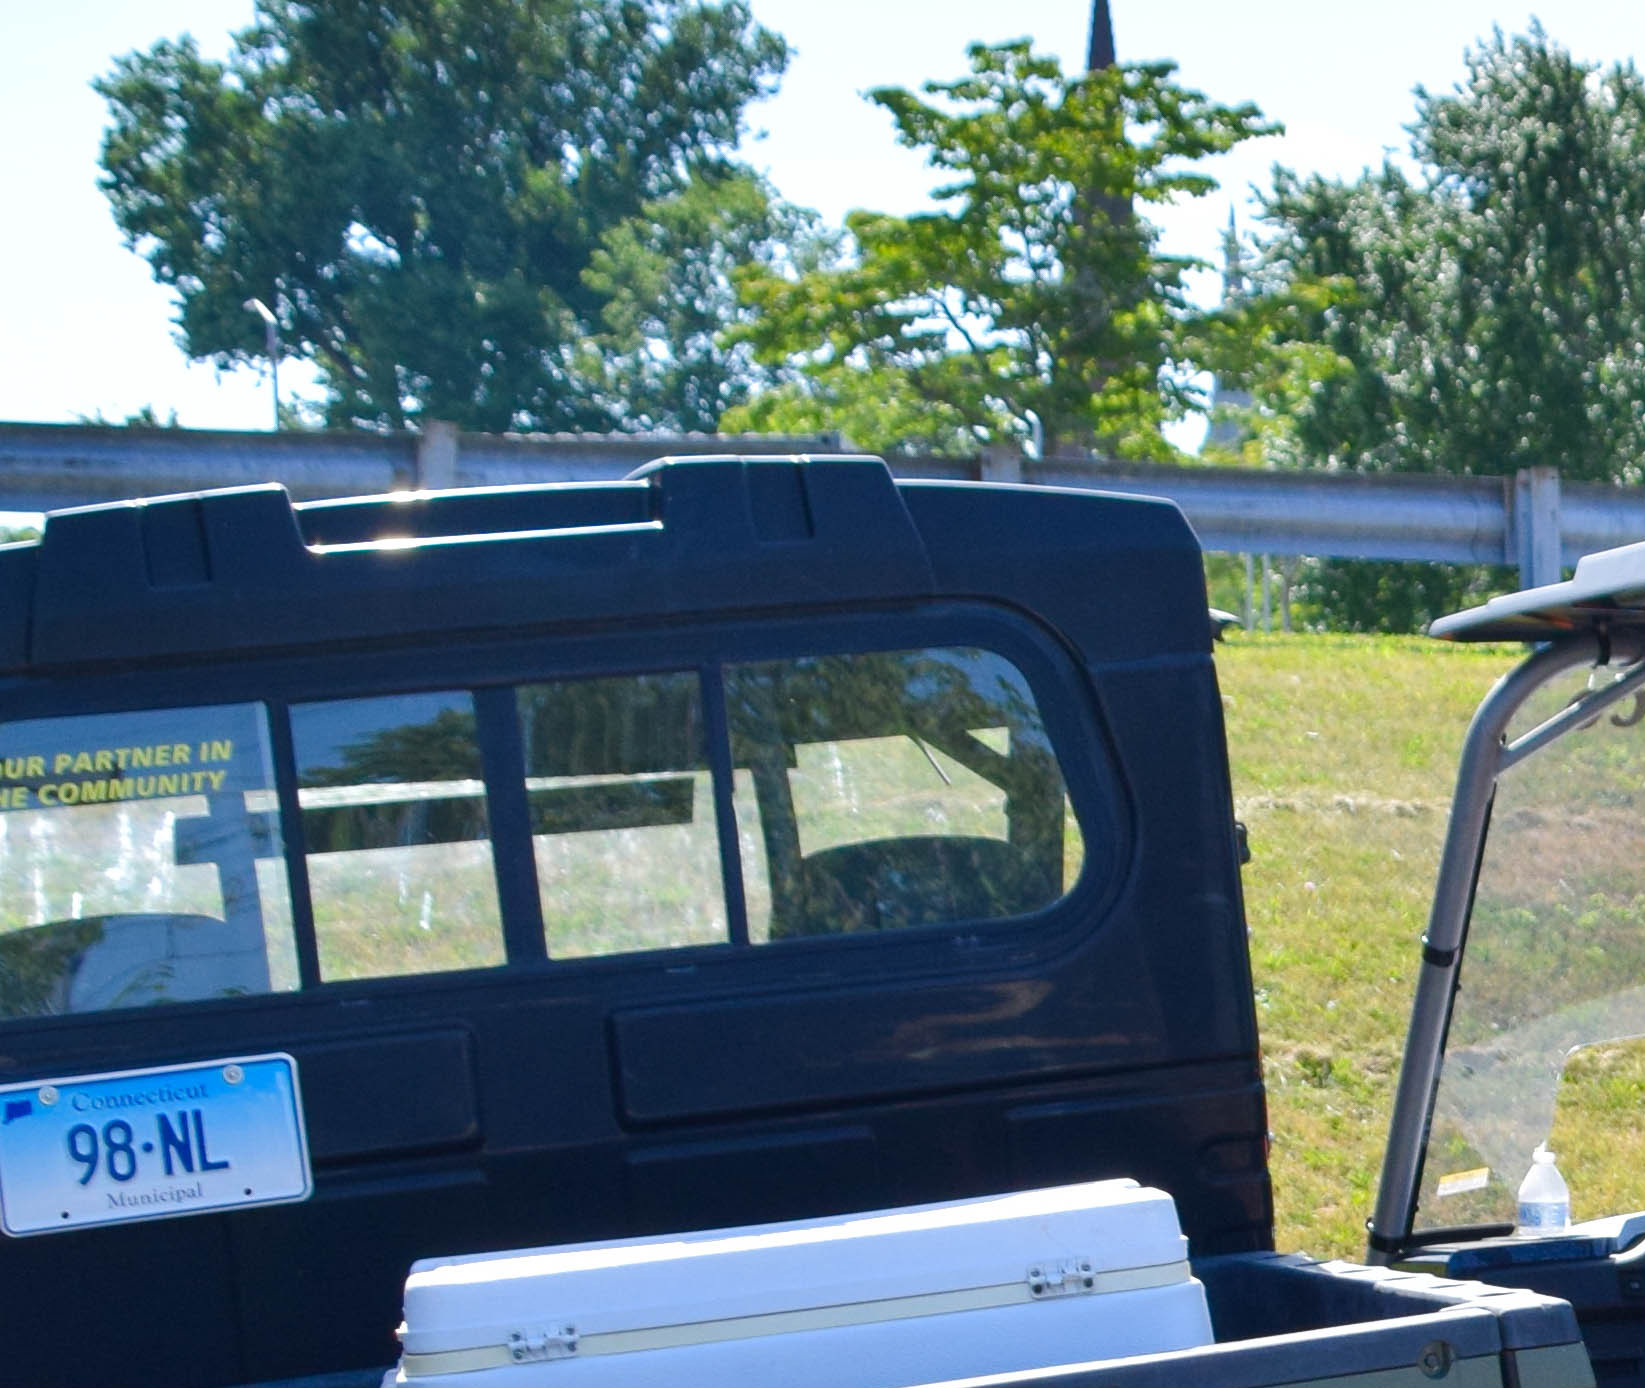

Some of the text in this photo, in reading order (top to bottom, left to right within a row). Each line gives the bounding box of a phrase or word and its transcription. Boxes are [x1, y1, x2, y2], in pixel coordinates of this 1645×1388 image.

[0, 740, 232, 780] UR PARTNER IN
[37, 770, 226, 806] COMMUNITY
[71, 1083, 209, 1112] Connecticut
[106, 1182, 205, 1209] Municipal
